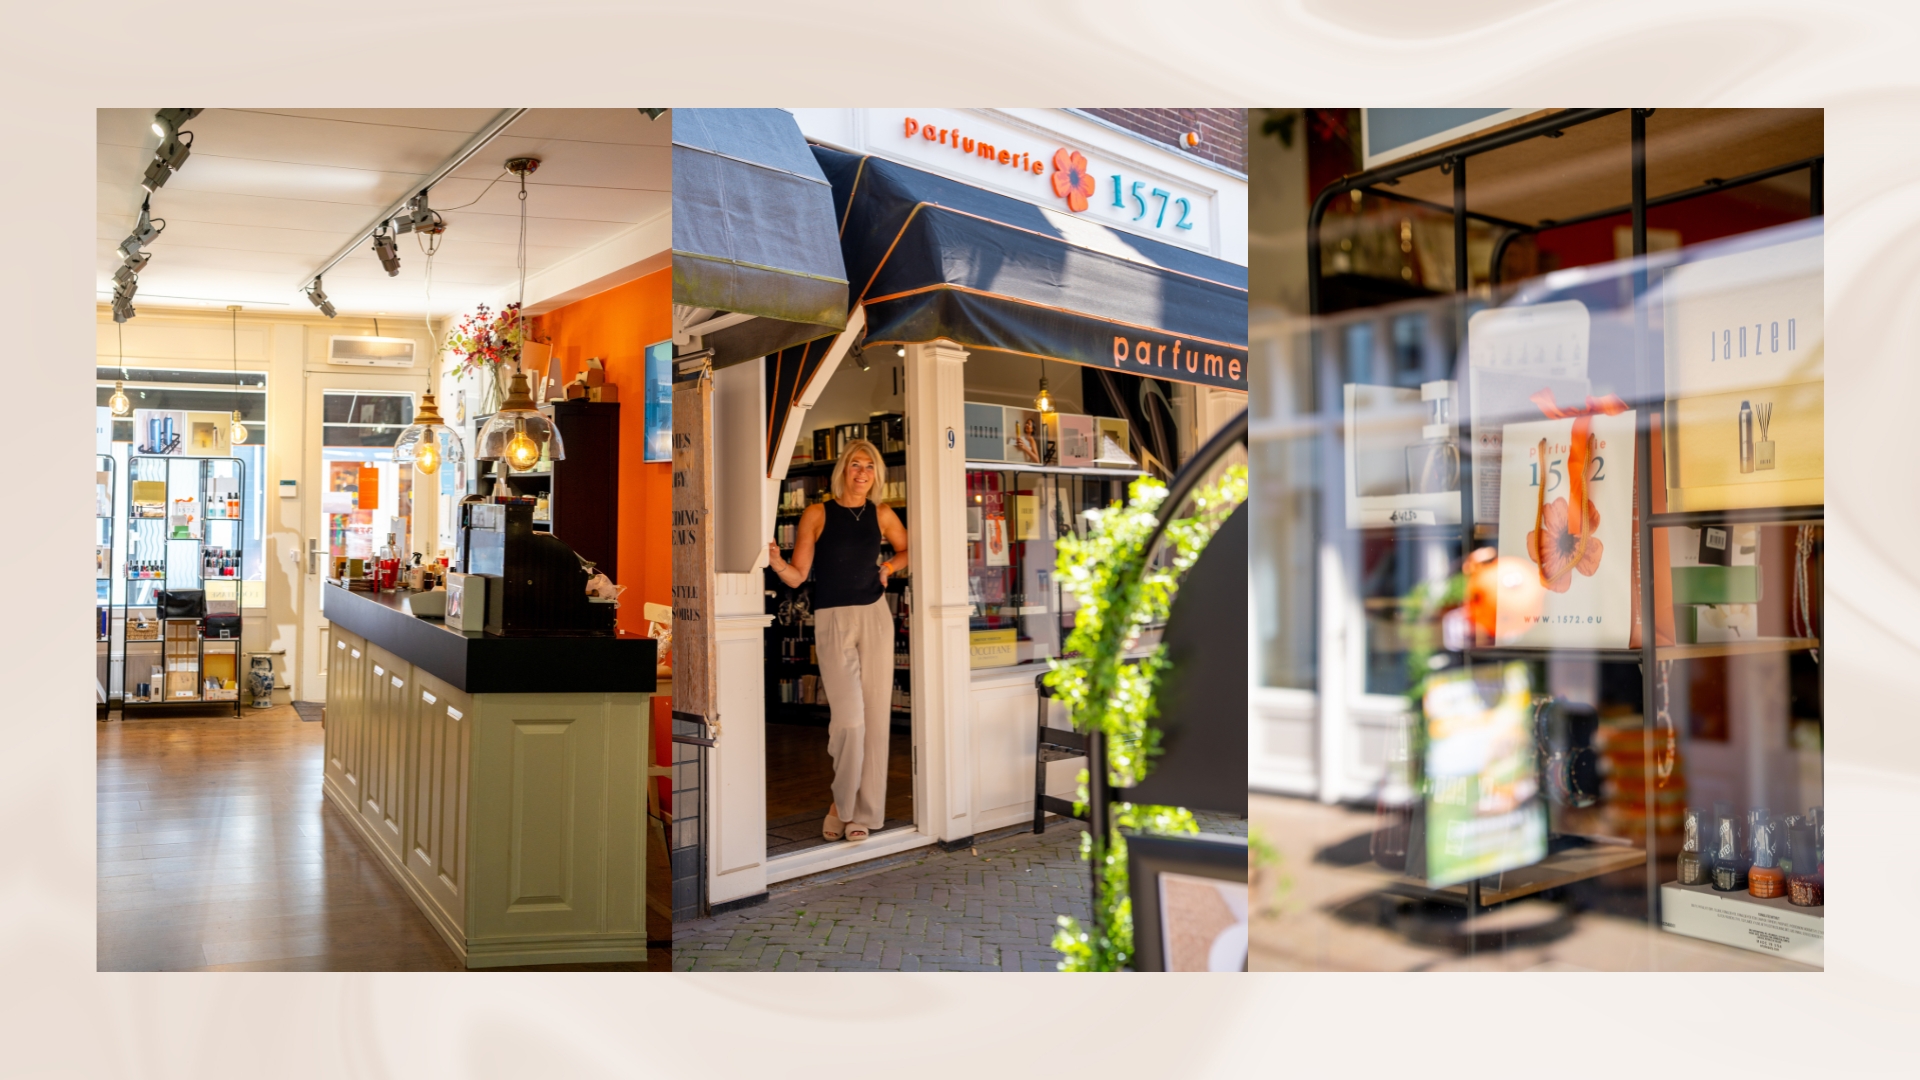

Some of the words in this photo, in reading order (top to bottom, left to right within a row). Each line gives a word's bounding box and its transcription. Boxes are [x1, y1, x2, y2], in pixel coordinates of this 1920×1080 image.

[904, 117, 1045, 175] parfumerie
[1110, 174, 1193, 230] 1572
[1113, 336, 1249, 382] parfume
[948, 430, 955, 449] 9
[1529, 439, 1606, 458] prfuie
[1529, 456, 1606, 492] 152
[1524, 615, 1602, 624] www.1572.eu
